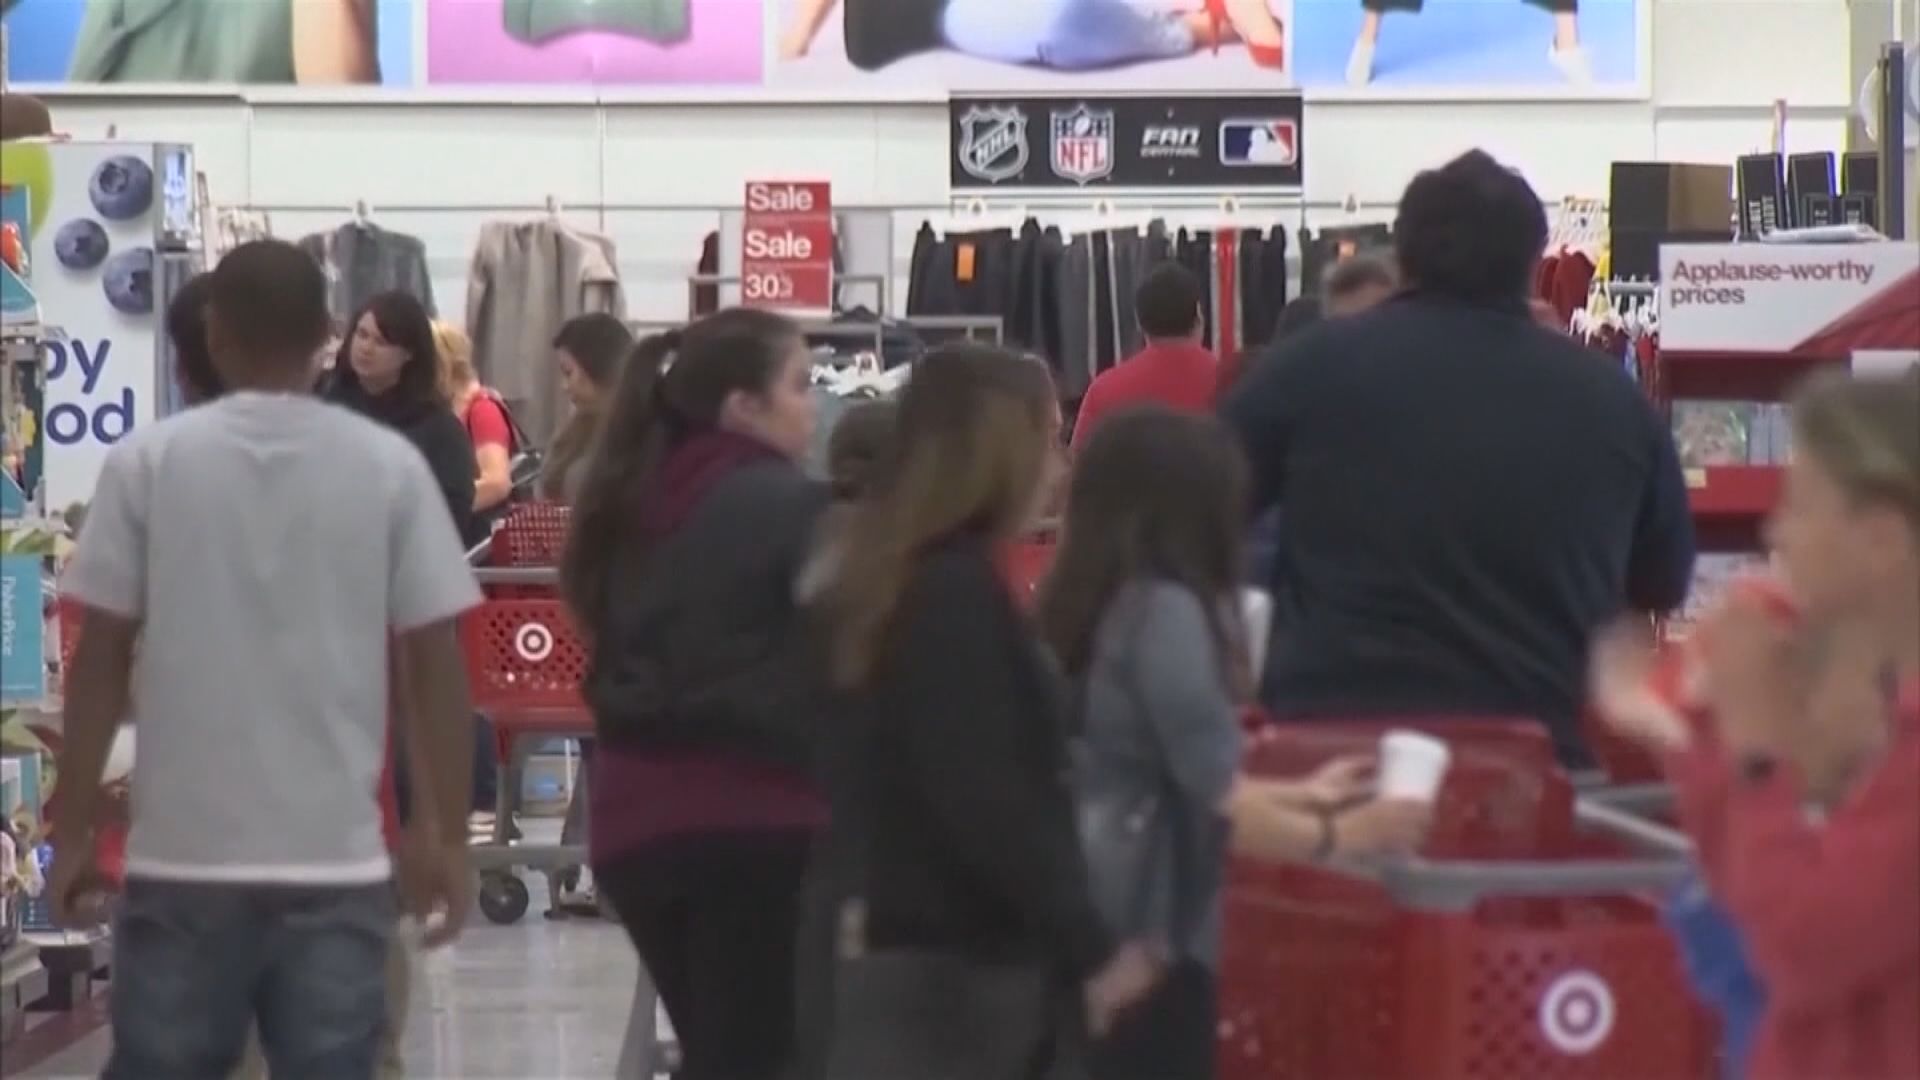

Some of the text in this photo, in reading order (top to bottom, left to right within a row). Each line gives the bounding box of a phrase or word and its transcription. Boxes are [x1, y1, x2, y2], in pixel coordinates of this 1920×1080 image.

[1142, 126, 1199, 146] FAN
[1061, 140, 1106, 172] NFL
[1139, 147, 1200, 158] CENTRAL
[748, 184, 814, 212] Sale
[745, 229, 812, 259] Sale
[1672, 259, 1874, 284] Applause-worthy
[1671, 286, 1745, 308] prices
